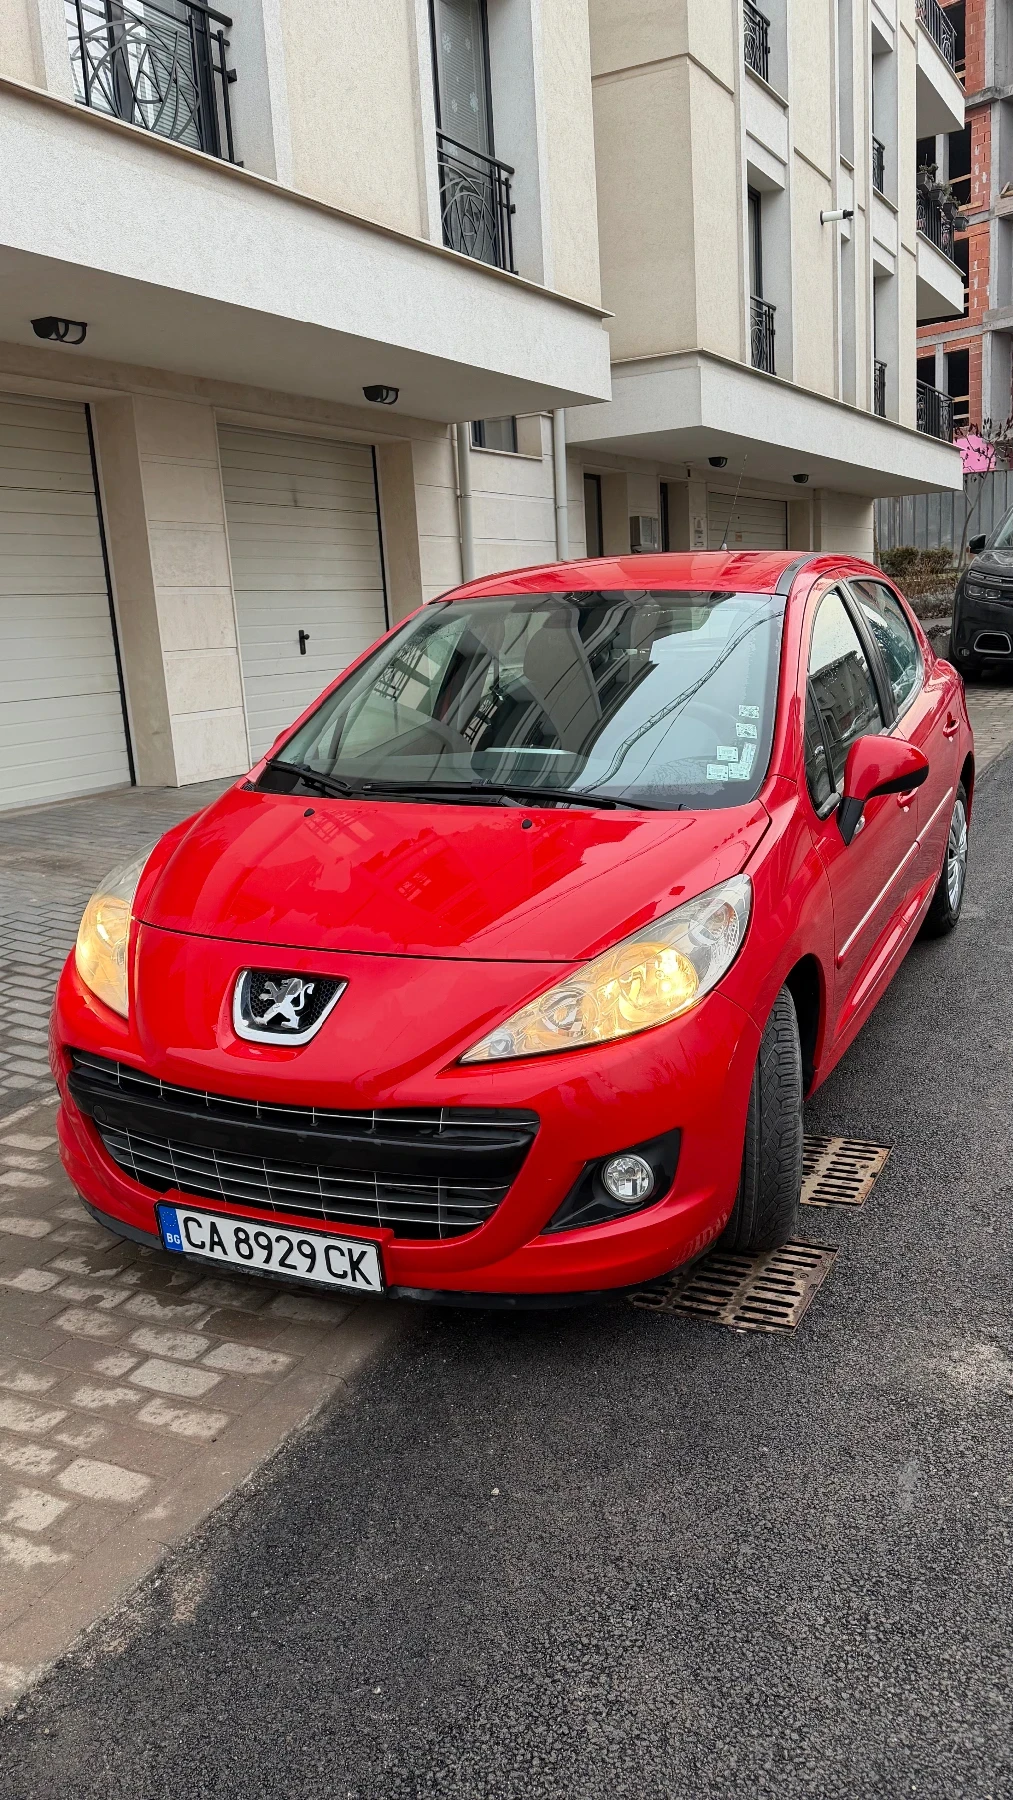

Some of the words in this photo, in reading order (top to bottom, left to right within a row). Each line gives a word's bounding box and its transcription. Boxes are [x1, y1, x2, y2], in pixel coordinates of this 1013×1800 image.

[166, 1232, 181, 1245] BG
[183, 1216, 228, 1256] CA
[233, 1226, 317, 1273] 8929
[324, 1245, 373, 1286] CK
